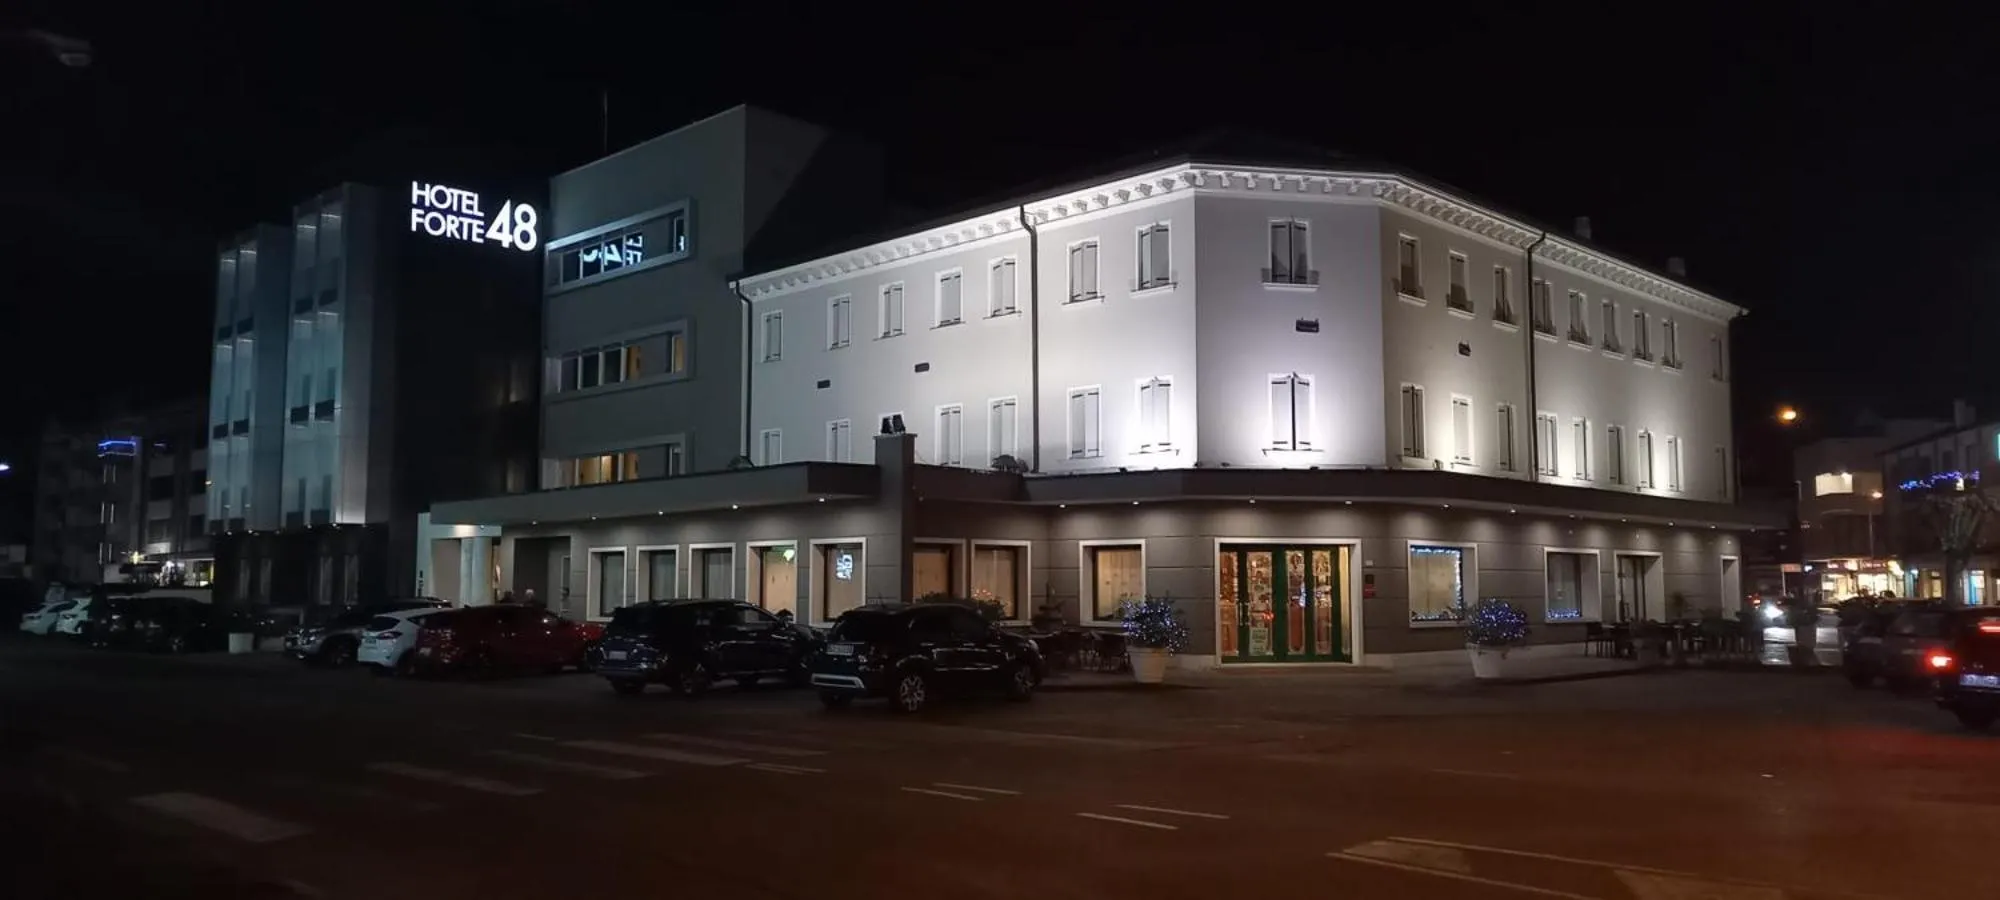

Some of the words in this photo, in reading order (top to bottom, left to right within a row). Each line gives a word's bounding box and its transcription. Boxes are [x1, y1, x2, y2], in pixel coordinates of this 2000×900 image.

[411, 181, 484, 217] HOTEL
[411, 208, 484, 243] FORTE
[486, 199, 537, 252] 48
